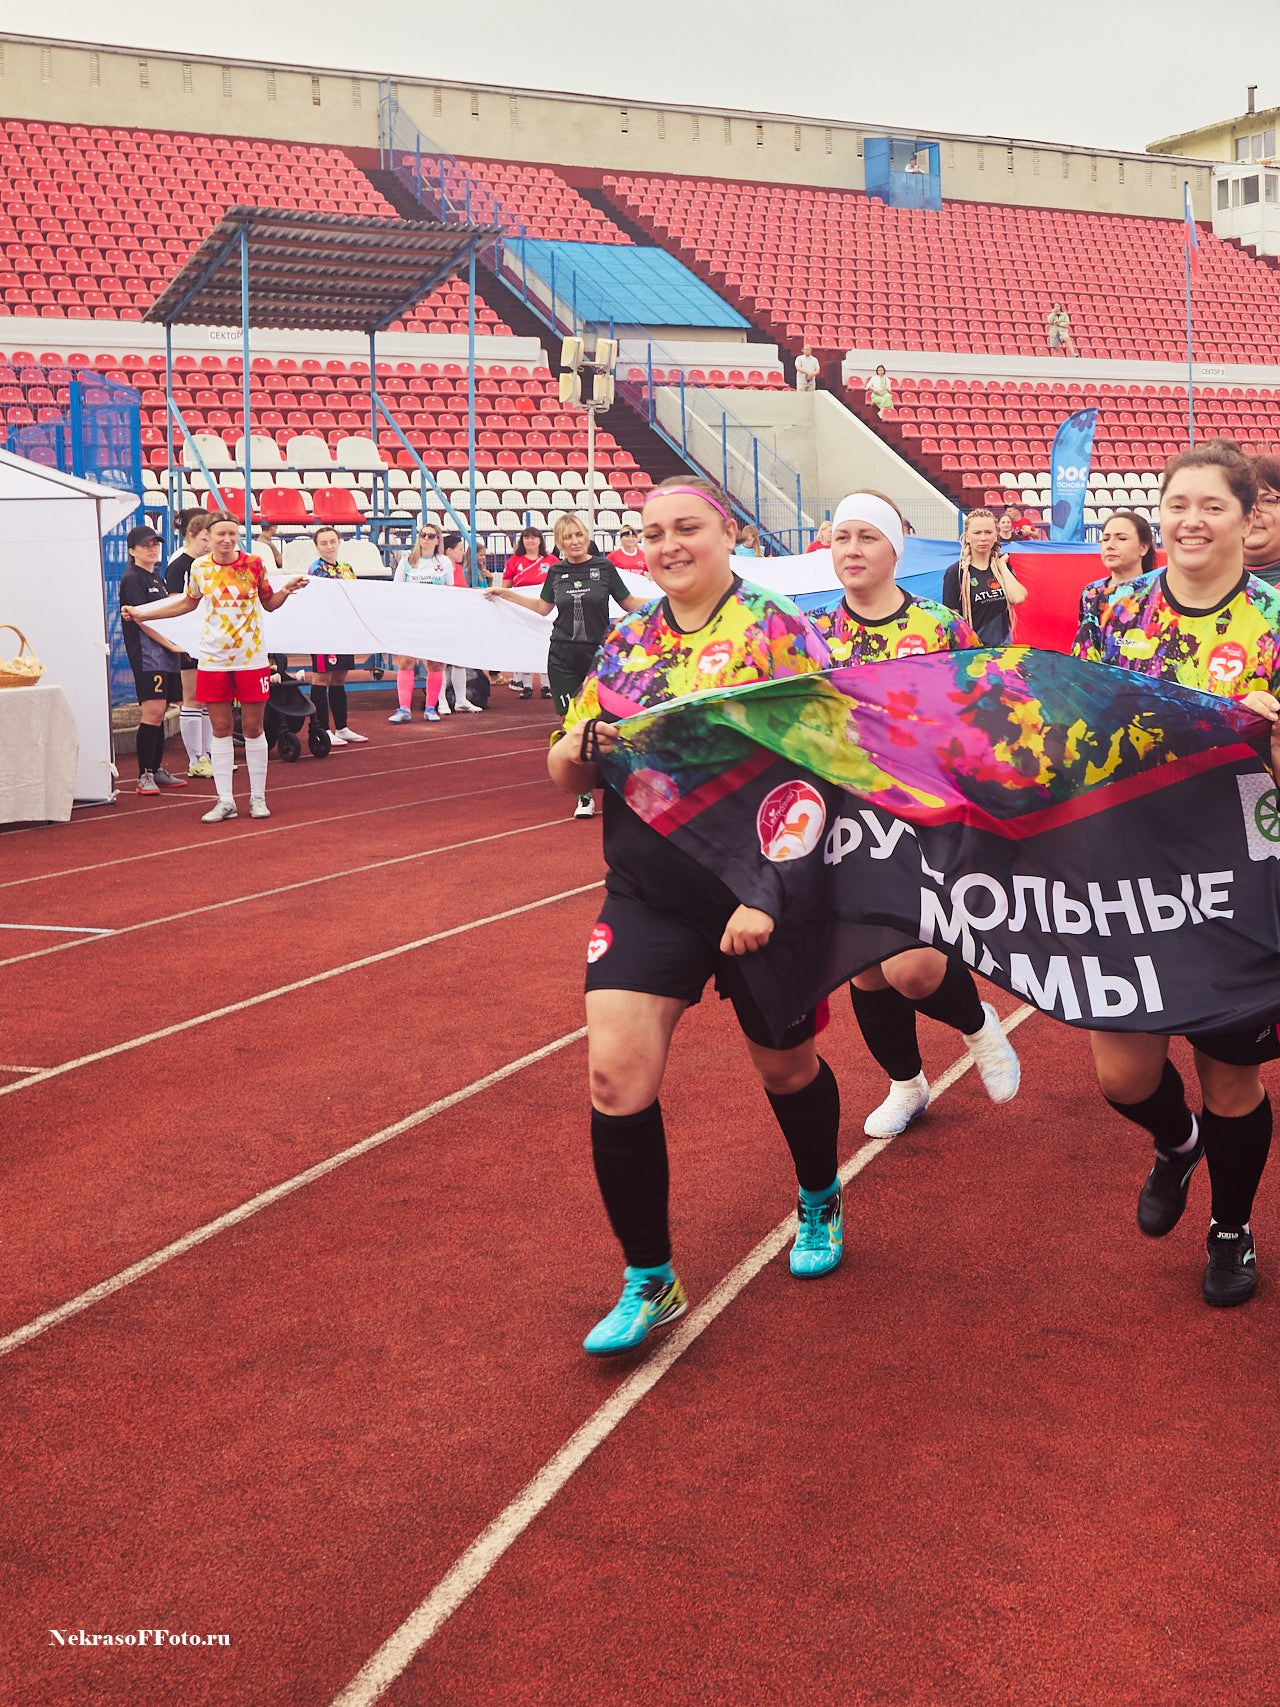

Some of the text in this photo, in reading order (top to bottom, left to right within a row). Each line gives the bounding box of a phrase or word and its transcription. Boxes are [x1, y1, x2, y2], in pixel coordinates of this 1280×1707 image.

[1056, 481, 1085, 489] ОСНОВА
[1209, 657, 1243, 681] 52
[153, 674, 163, 693] 2
[260, 676, 269, 694] 15
[823, 809, 1234, 937] ФУОЛЬНЫЕ
[918, 886, 1165, 1021] ММЫ
